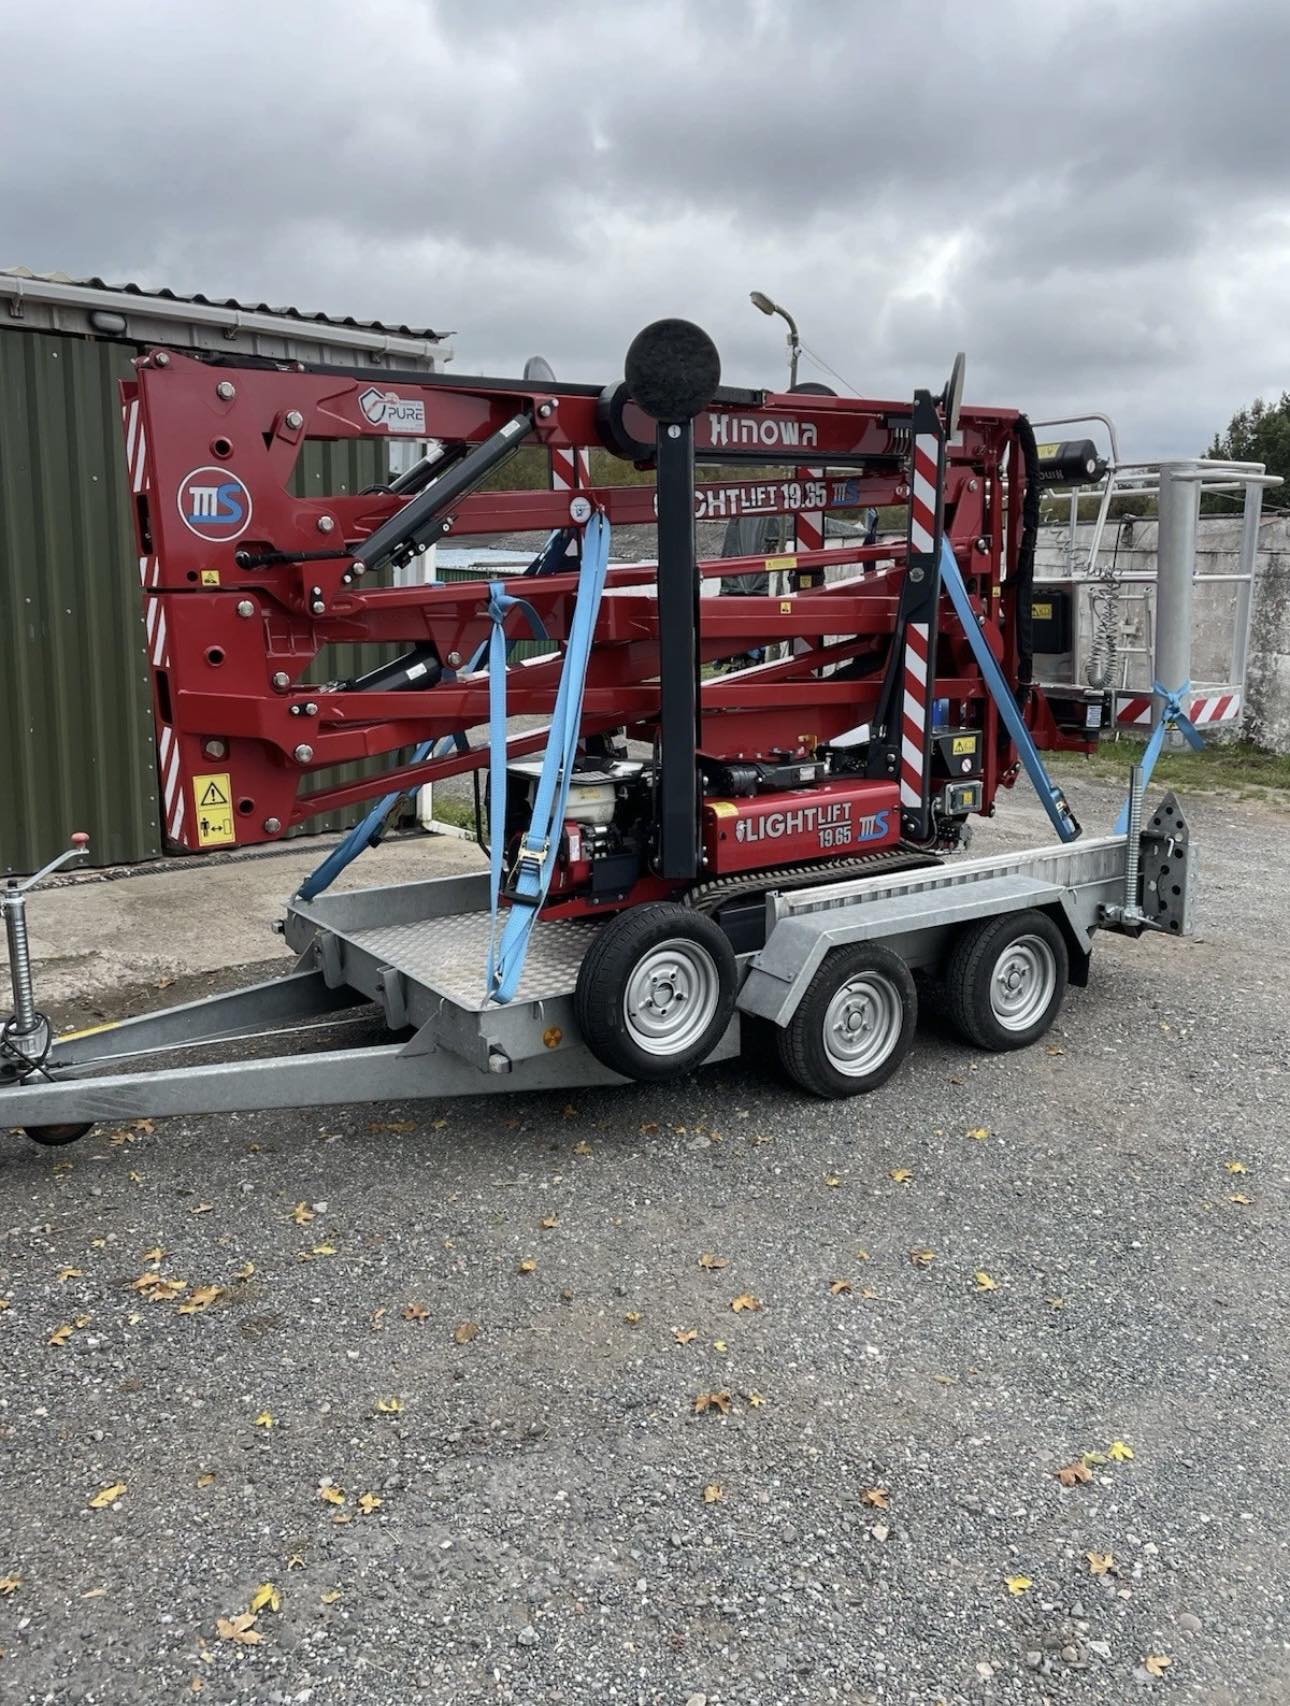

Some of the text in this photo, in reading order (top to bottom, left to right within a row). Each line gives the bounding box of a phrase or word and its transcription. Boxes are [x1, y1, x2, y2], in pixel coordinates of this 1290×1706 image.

[388, 407, 423, 421] PURE
[781, 481, 828, 510] 19.65
[818, 826, 852, 849] 19.65
